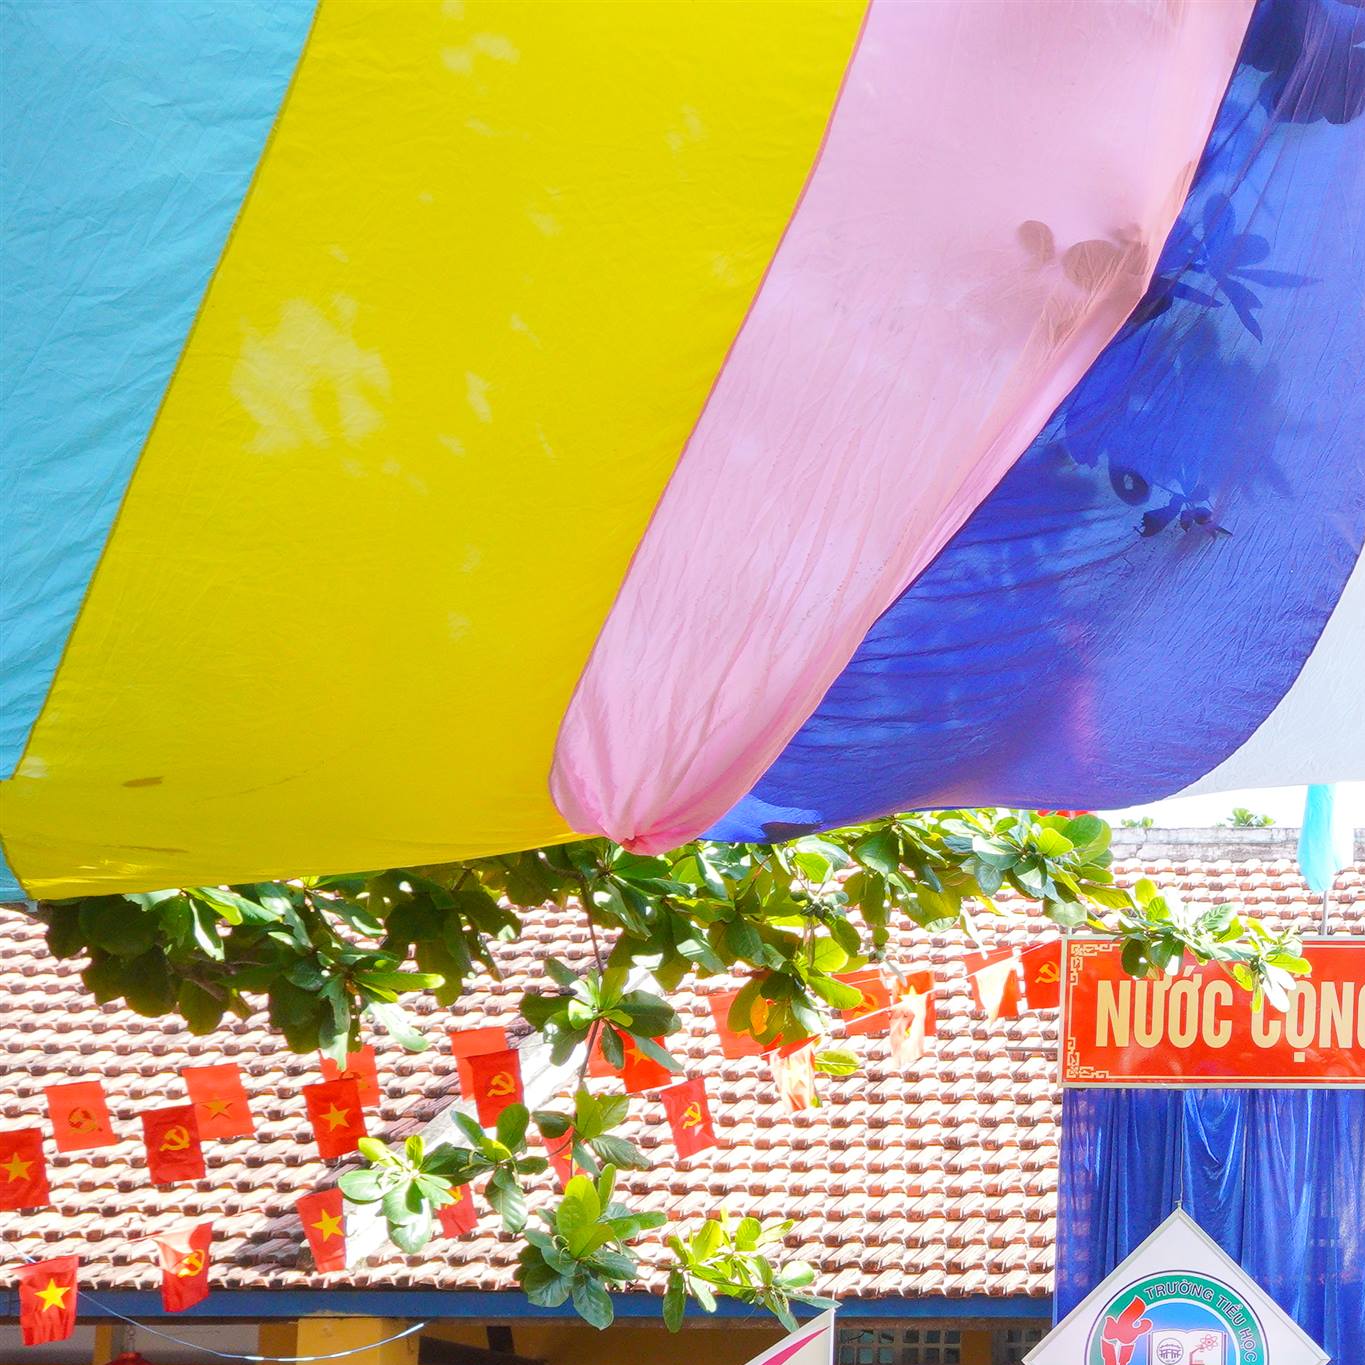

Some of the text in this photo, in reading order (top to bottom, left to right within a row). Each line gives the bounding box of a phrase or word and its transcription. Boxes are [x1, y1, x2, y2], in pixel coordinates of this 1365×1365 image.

[1095, 965, 1233, 1049] NƯỚC
[1144, 1279, 1258, 1363] TRƯỜNG TIỂU HỌC
